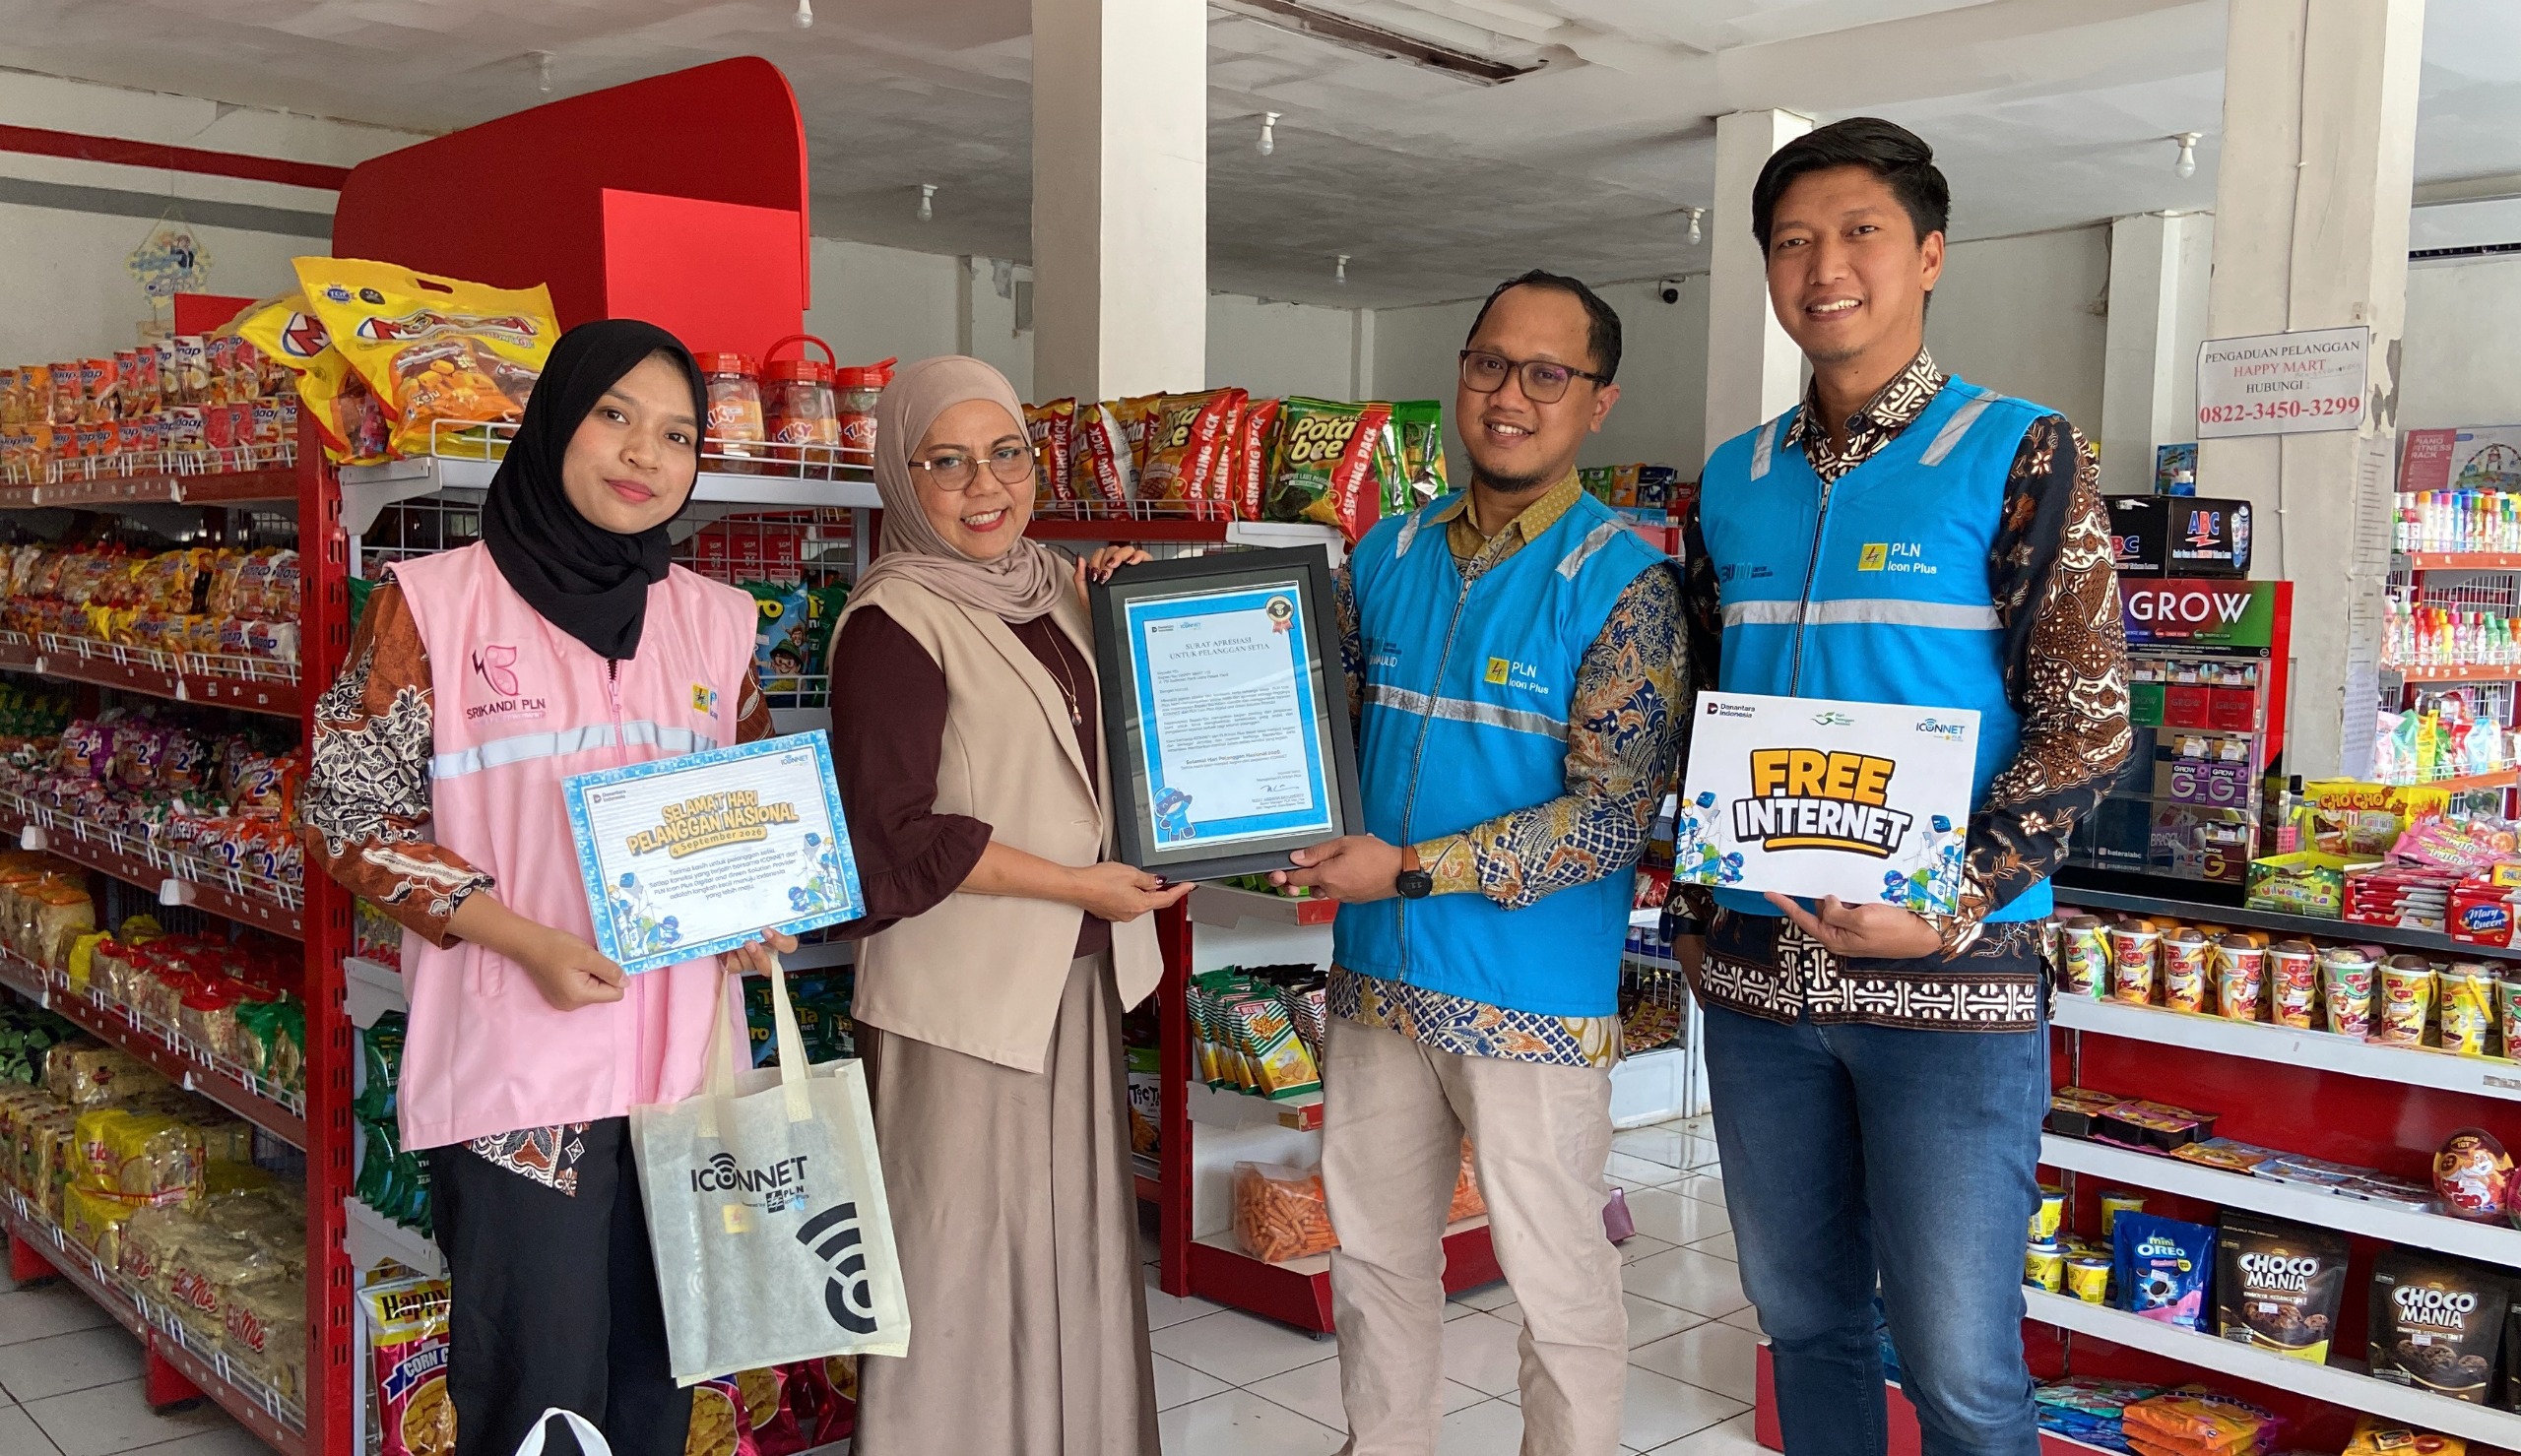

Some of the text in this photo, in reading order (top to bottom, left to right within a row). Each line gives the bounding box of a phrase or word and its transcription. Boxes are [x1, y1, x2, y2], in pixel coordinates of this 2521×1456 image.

[2205, 341, 2360, 364] PENGADUAN PELANGGAN
[2233, 361, 2281, 378] HAPPY
[2282, 358, 2327, 374] MART
[2199, 396, 2360, 424] 0822-3450-3299
[778, 421, 813, 444] TIKY
[1054, 418, 1068, 448] PACK
[1291, 416, 1358, 441] Pota
[1088, 426, 1108, 455] PACK
[1290, 435, 1345, 462] bee
[1357, 426, 1378, 460] PACK
[2187, 510, 2220, 536] ABC
[1891, 543, 1921, 557] PLN
[2110, 535, 2140, 553] BC
[1888, 562, 1937, 574] Icon Plus
[2128, 591, 2252, 624] GROW
[1186, 641, 1211, 650] SURAT
[1512, 661, 1537, 678] PLN
[1529, 681, 1549, 695] Plus
[466, 700, 517, 721] SRIKANDI
[521, 698, 547, 711] PLN
[1719, 710, 1753, 719] Indonesia
[1720, 703, 1756, 713] Danantara
[1915, 718, 1966, 735] ICONNET
[1751, 748, 1896, 806] FREE
[2173, 765, 2196, 774] GROW
[2212, 768, 2235, 777] GROW
[662, 790, 759, 826] SELAMAT HARI
[2319, 792, 2385, 810] CHO CHO
[625, 801, 800, 856] PELANGGAN NASIONAL
[1734, 797, 1912, 851] INTERNET
[680, 832, 738, 851] September
[739, 829, 762, 838] 2026
[2468, 909, 2499, 920] Mary
[2473, 918, 2502, 930] Queen
[690, 1153, 808, 1193] ICONNET
[783, 1184, 805, 1199] PLN
[2136, 1243, 2186, 1257] OREO
[2149, 1235, 2175, 1247] mini
[2238, 1251, 2318, 1277] CHOCO
[2246, 1271, 2308, 1293] MANIA
[381, 1287, 450, 1321] Happy
[2394, 1286, 2476, 1313] CHOCO
[2400, 1304, 2464, 1329] MANIA
[403, 1350, 438, 1378] CORN
